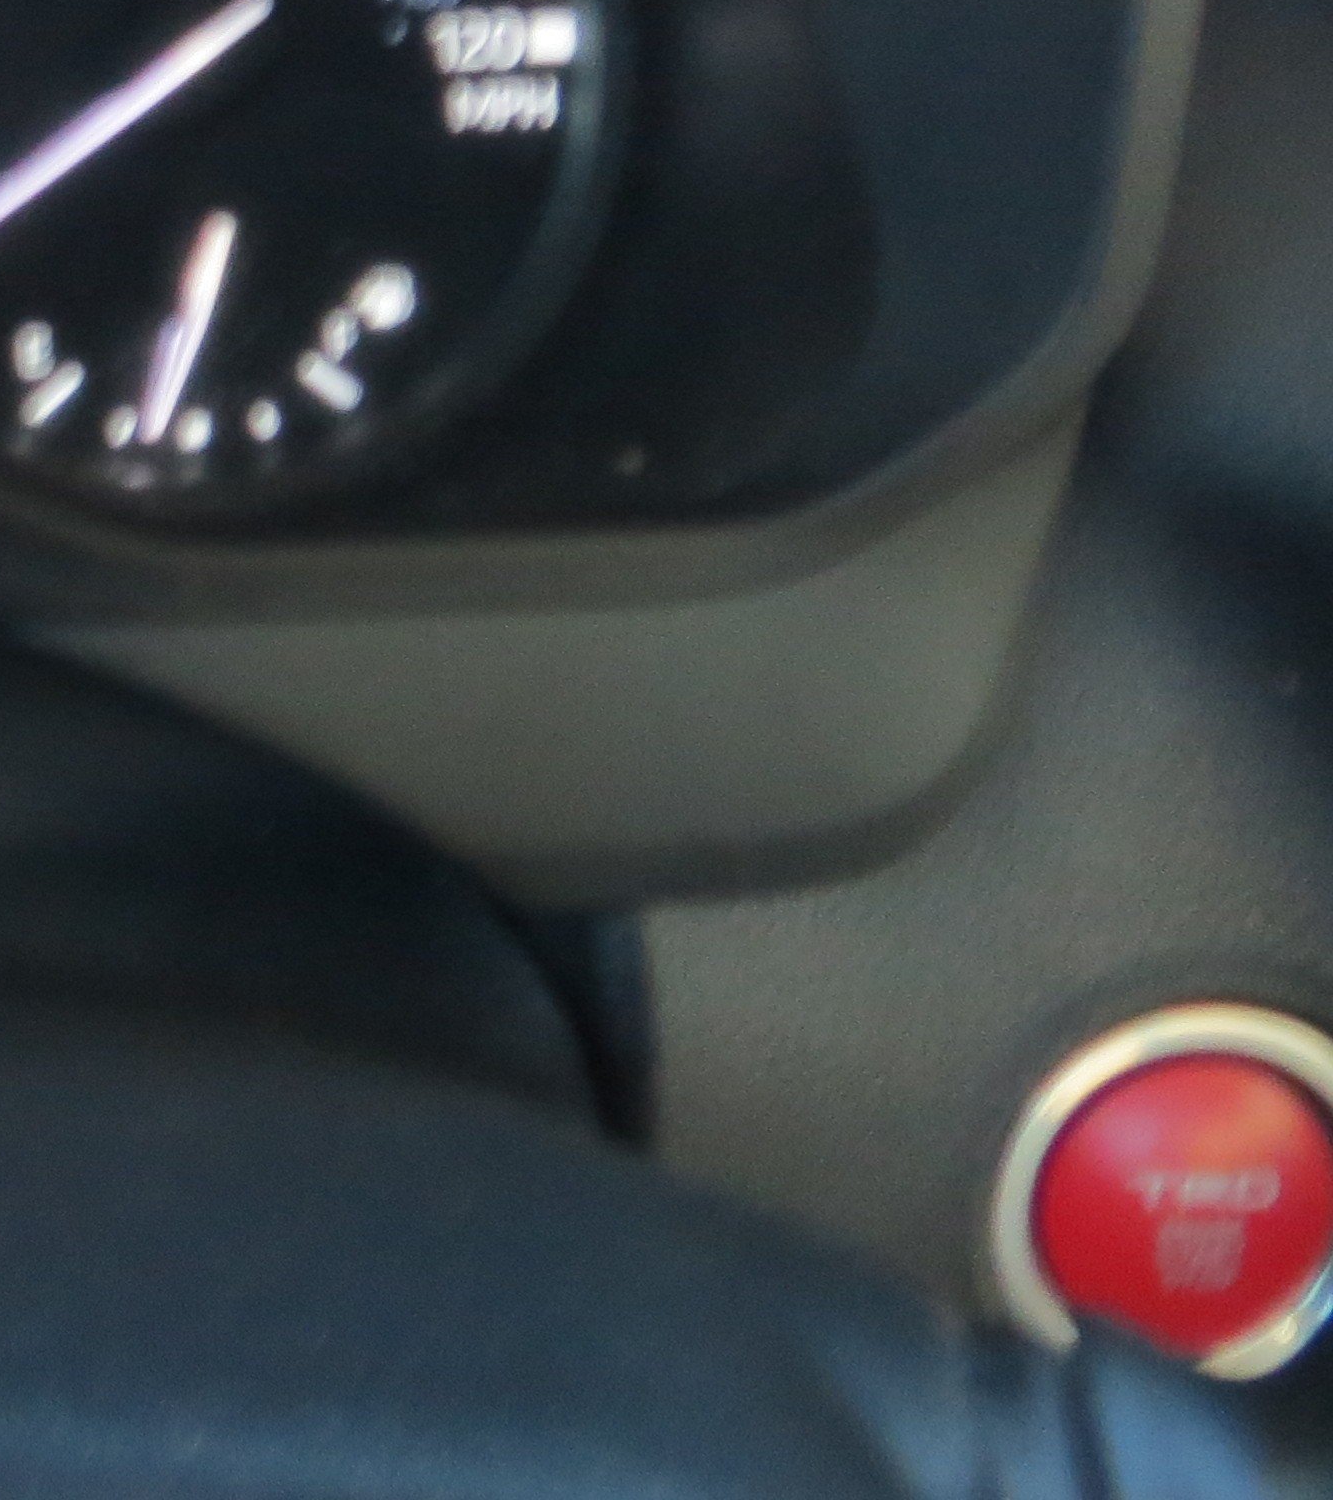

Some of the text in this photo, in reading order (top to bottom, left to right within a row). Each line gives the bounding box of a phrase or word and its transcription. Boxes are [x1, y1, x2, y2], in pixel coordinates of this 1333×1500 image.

[428, 5, 528, 72] 120
[445, 75, 560, 133] MPH
[1136, 1166, 1280, 1211] TRD
